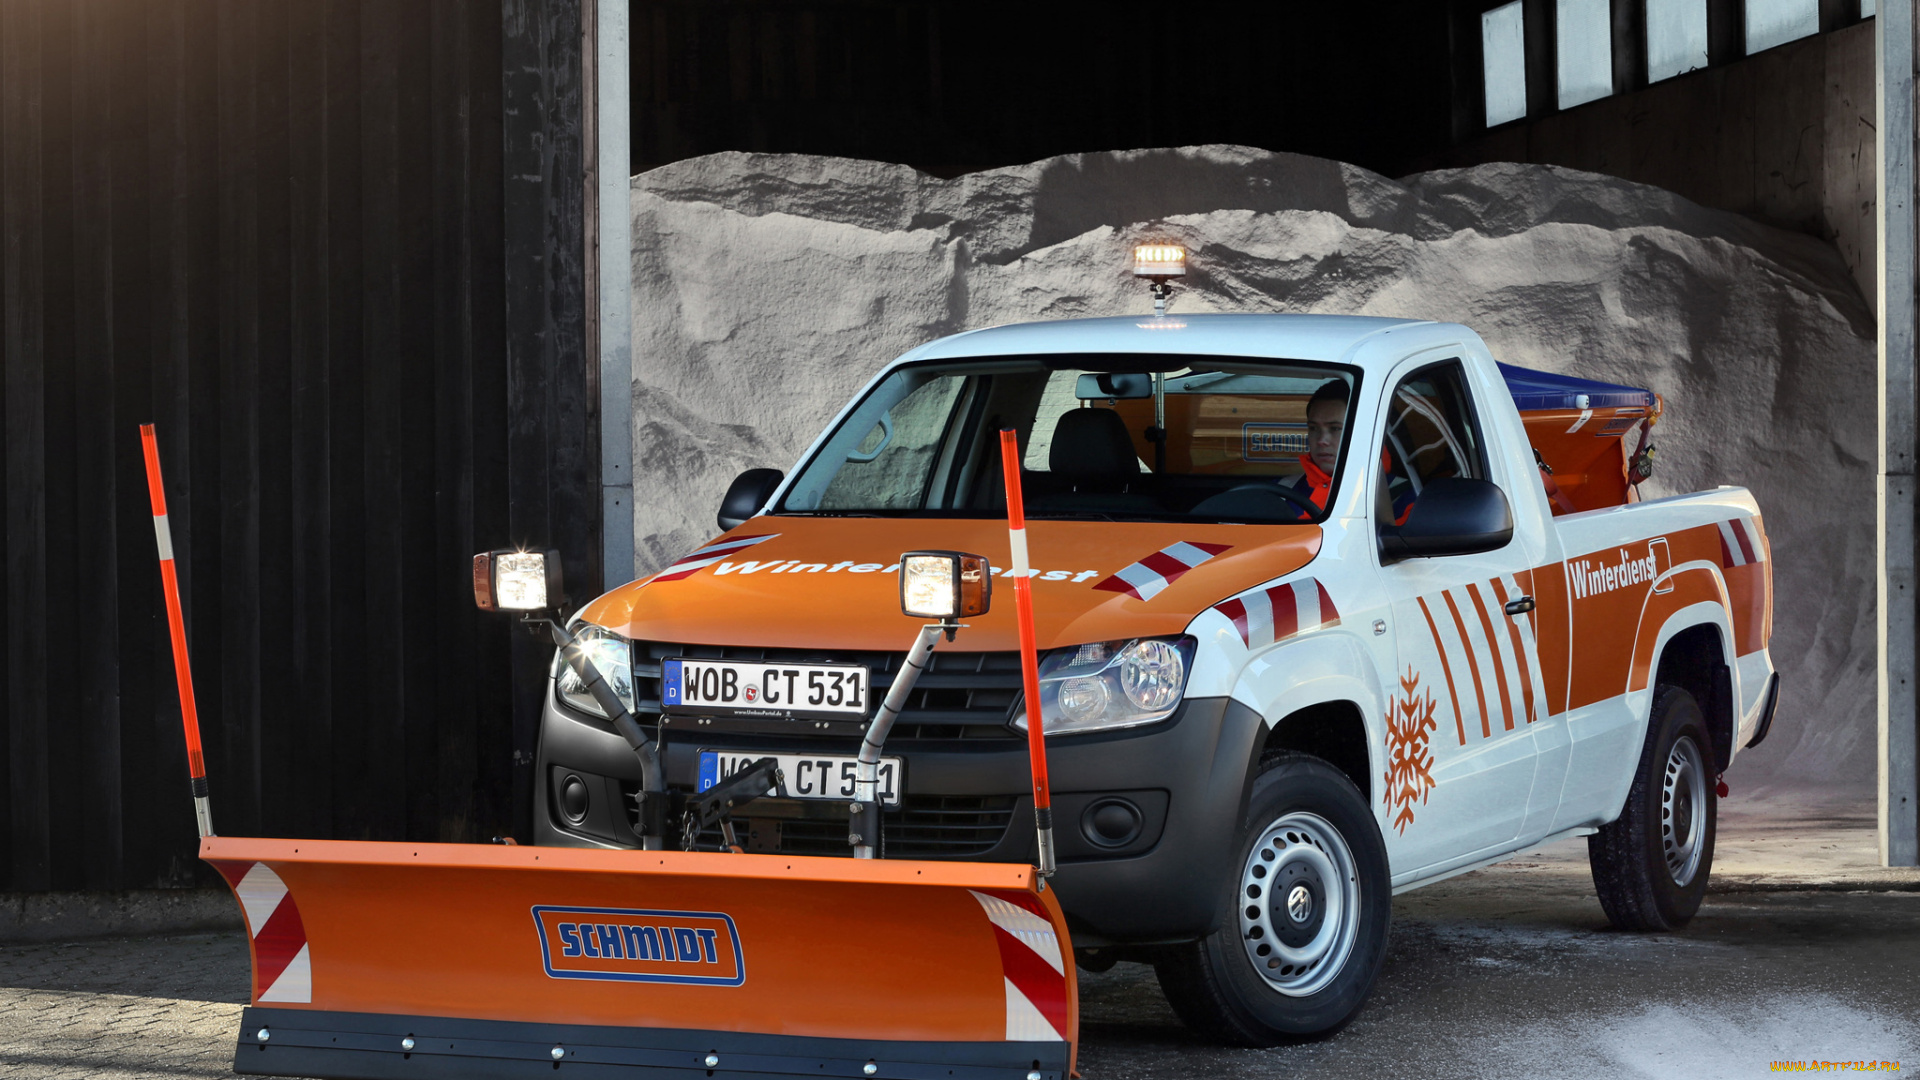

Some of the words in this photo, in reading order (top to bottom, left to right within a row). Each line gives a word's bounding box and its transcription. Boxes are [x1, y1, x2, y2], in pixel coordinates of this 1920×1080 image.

[1251, 433, 1311, 452] SCHMI
[1569, 548, 1657, 599] Winterdienst
[669, 687, 677, 698] D
[684, 666, 738, 702] WOB
[763, 669, 799, 704] CT
[808, 671, 862, 707] 531
[704, 778, 712, 789] D
[796, 760, 833, 795] CT
[840, 762, 894, 798] 51
[557, 922, 718, 964] SCHMIDT
